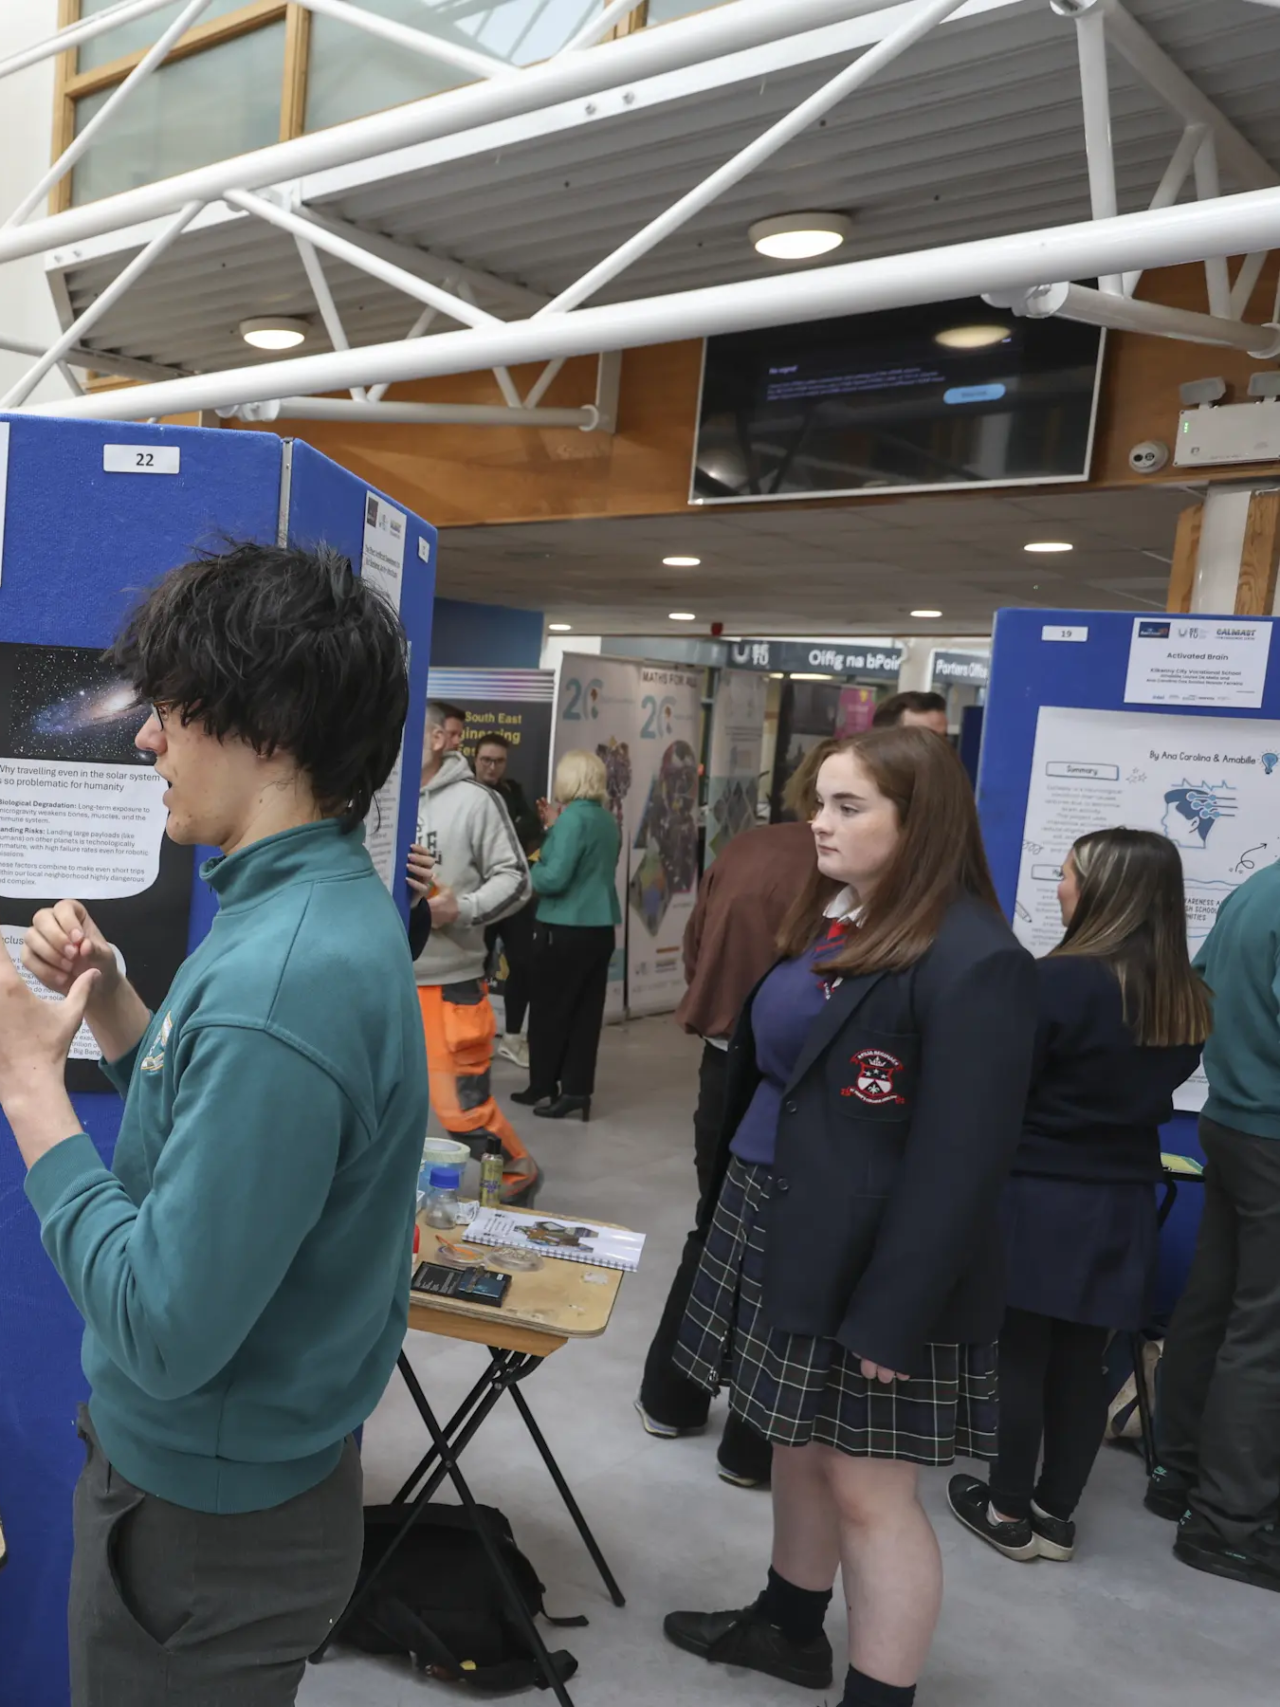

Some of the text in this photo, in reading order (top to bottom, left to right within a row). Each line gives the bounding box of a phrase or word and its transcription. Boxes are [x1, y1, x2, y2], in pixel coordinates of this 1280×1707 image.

[136, 453, 154, 468] 22
[1061, 630, 1072, 638] 19
[1216, 628, 1256, 636] CALMAST
[809, 650, 844, 671] Oifig
[846, 654, 864, 668] na
[1166, 652, 1206, 660] Activated
[936, 659, 968, 676] Porters
[643, 671, 668, 685] MATHS
[465, 711, 522, 724] South East
[1150, 750, 1160, 762] By
[1162, 752, 1178, 760] Ana
[1180, 752, 1211, 762] Carolina
[1223, 754, 1256, 764] Amabille
[17, 766, 56, 778] travelling
[90, 770, 104, 778] the
[106, 771, 128, 780] solar
[129, 772, 160, 782] system
[17, 778, 68, 788] problematic
[71, 780, 83, 789] for
[84, 781, 124, 793] humanity
